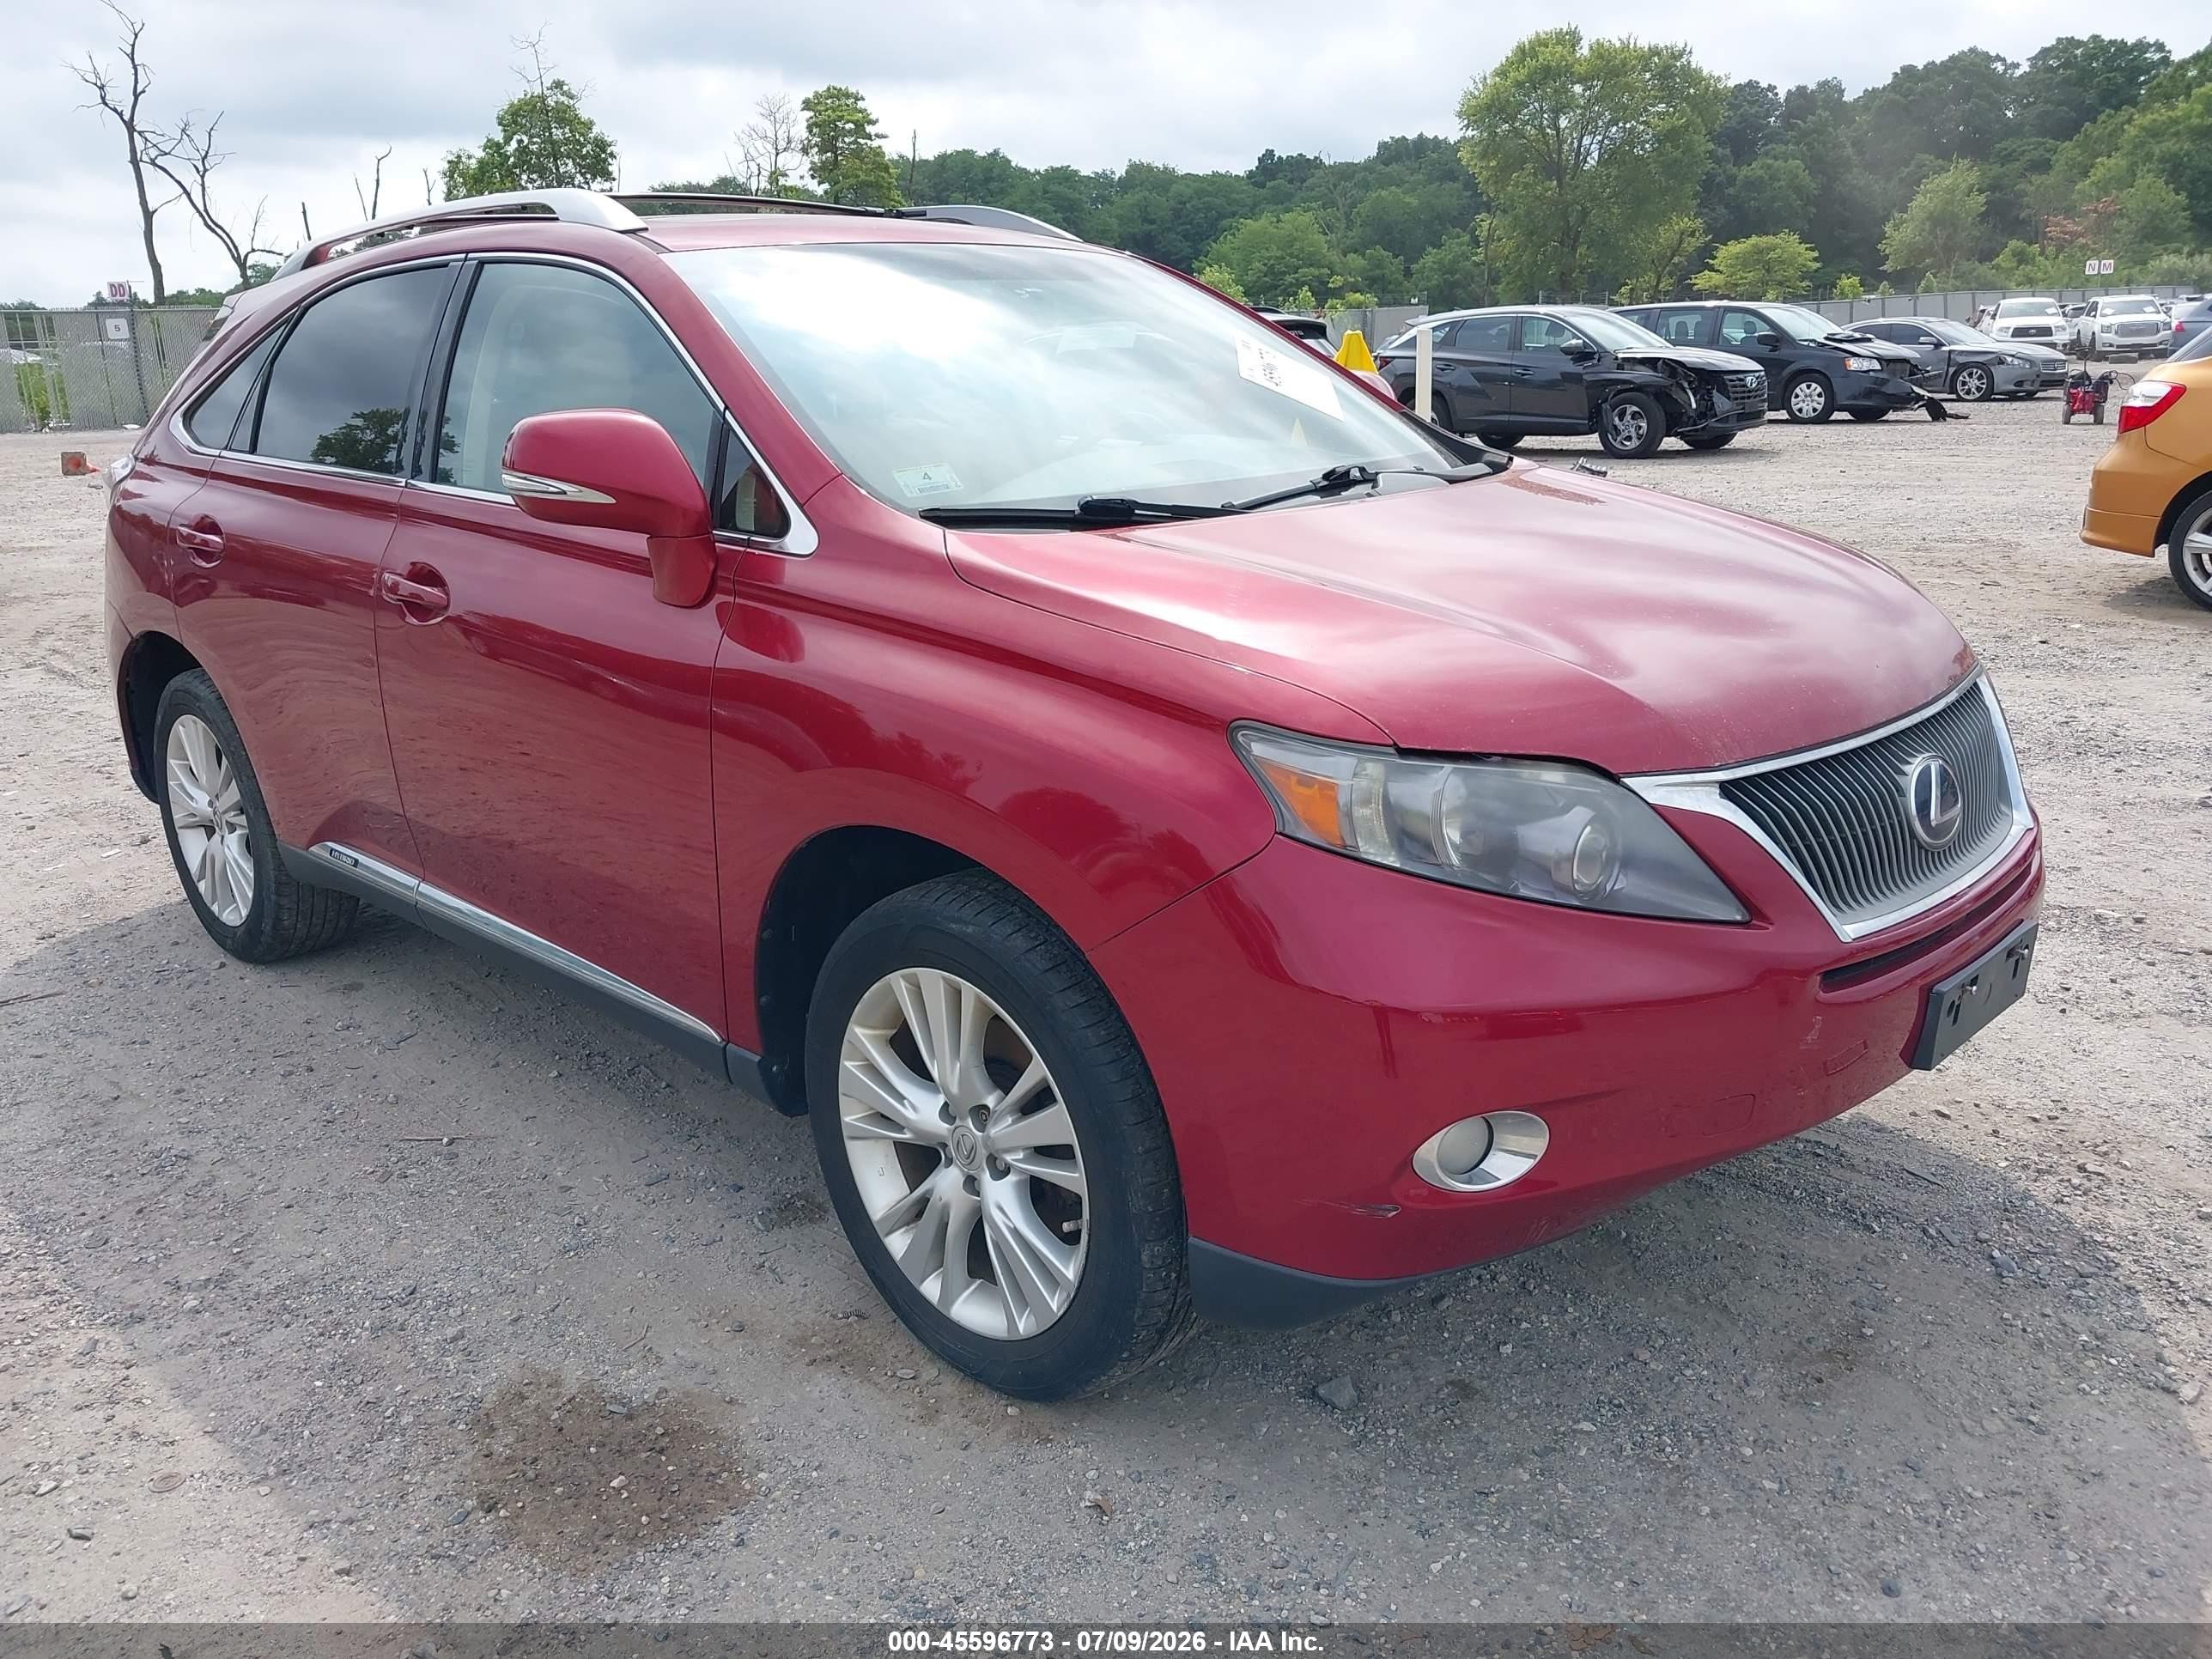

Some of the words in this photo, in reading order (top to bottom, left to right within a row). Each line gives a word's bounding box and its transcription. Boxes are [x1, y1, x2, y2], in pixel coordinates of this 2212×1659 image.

[2088, 263, 2096, 271] N
[2102, 262, 2112, 271] M
[109, 283, 126, 298] DD
[113, 324, 121, 332] 5
